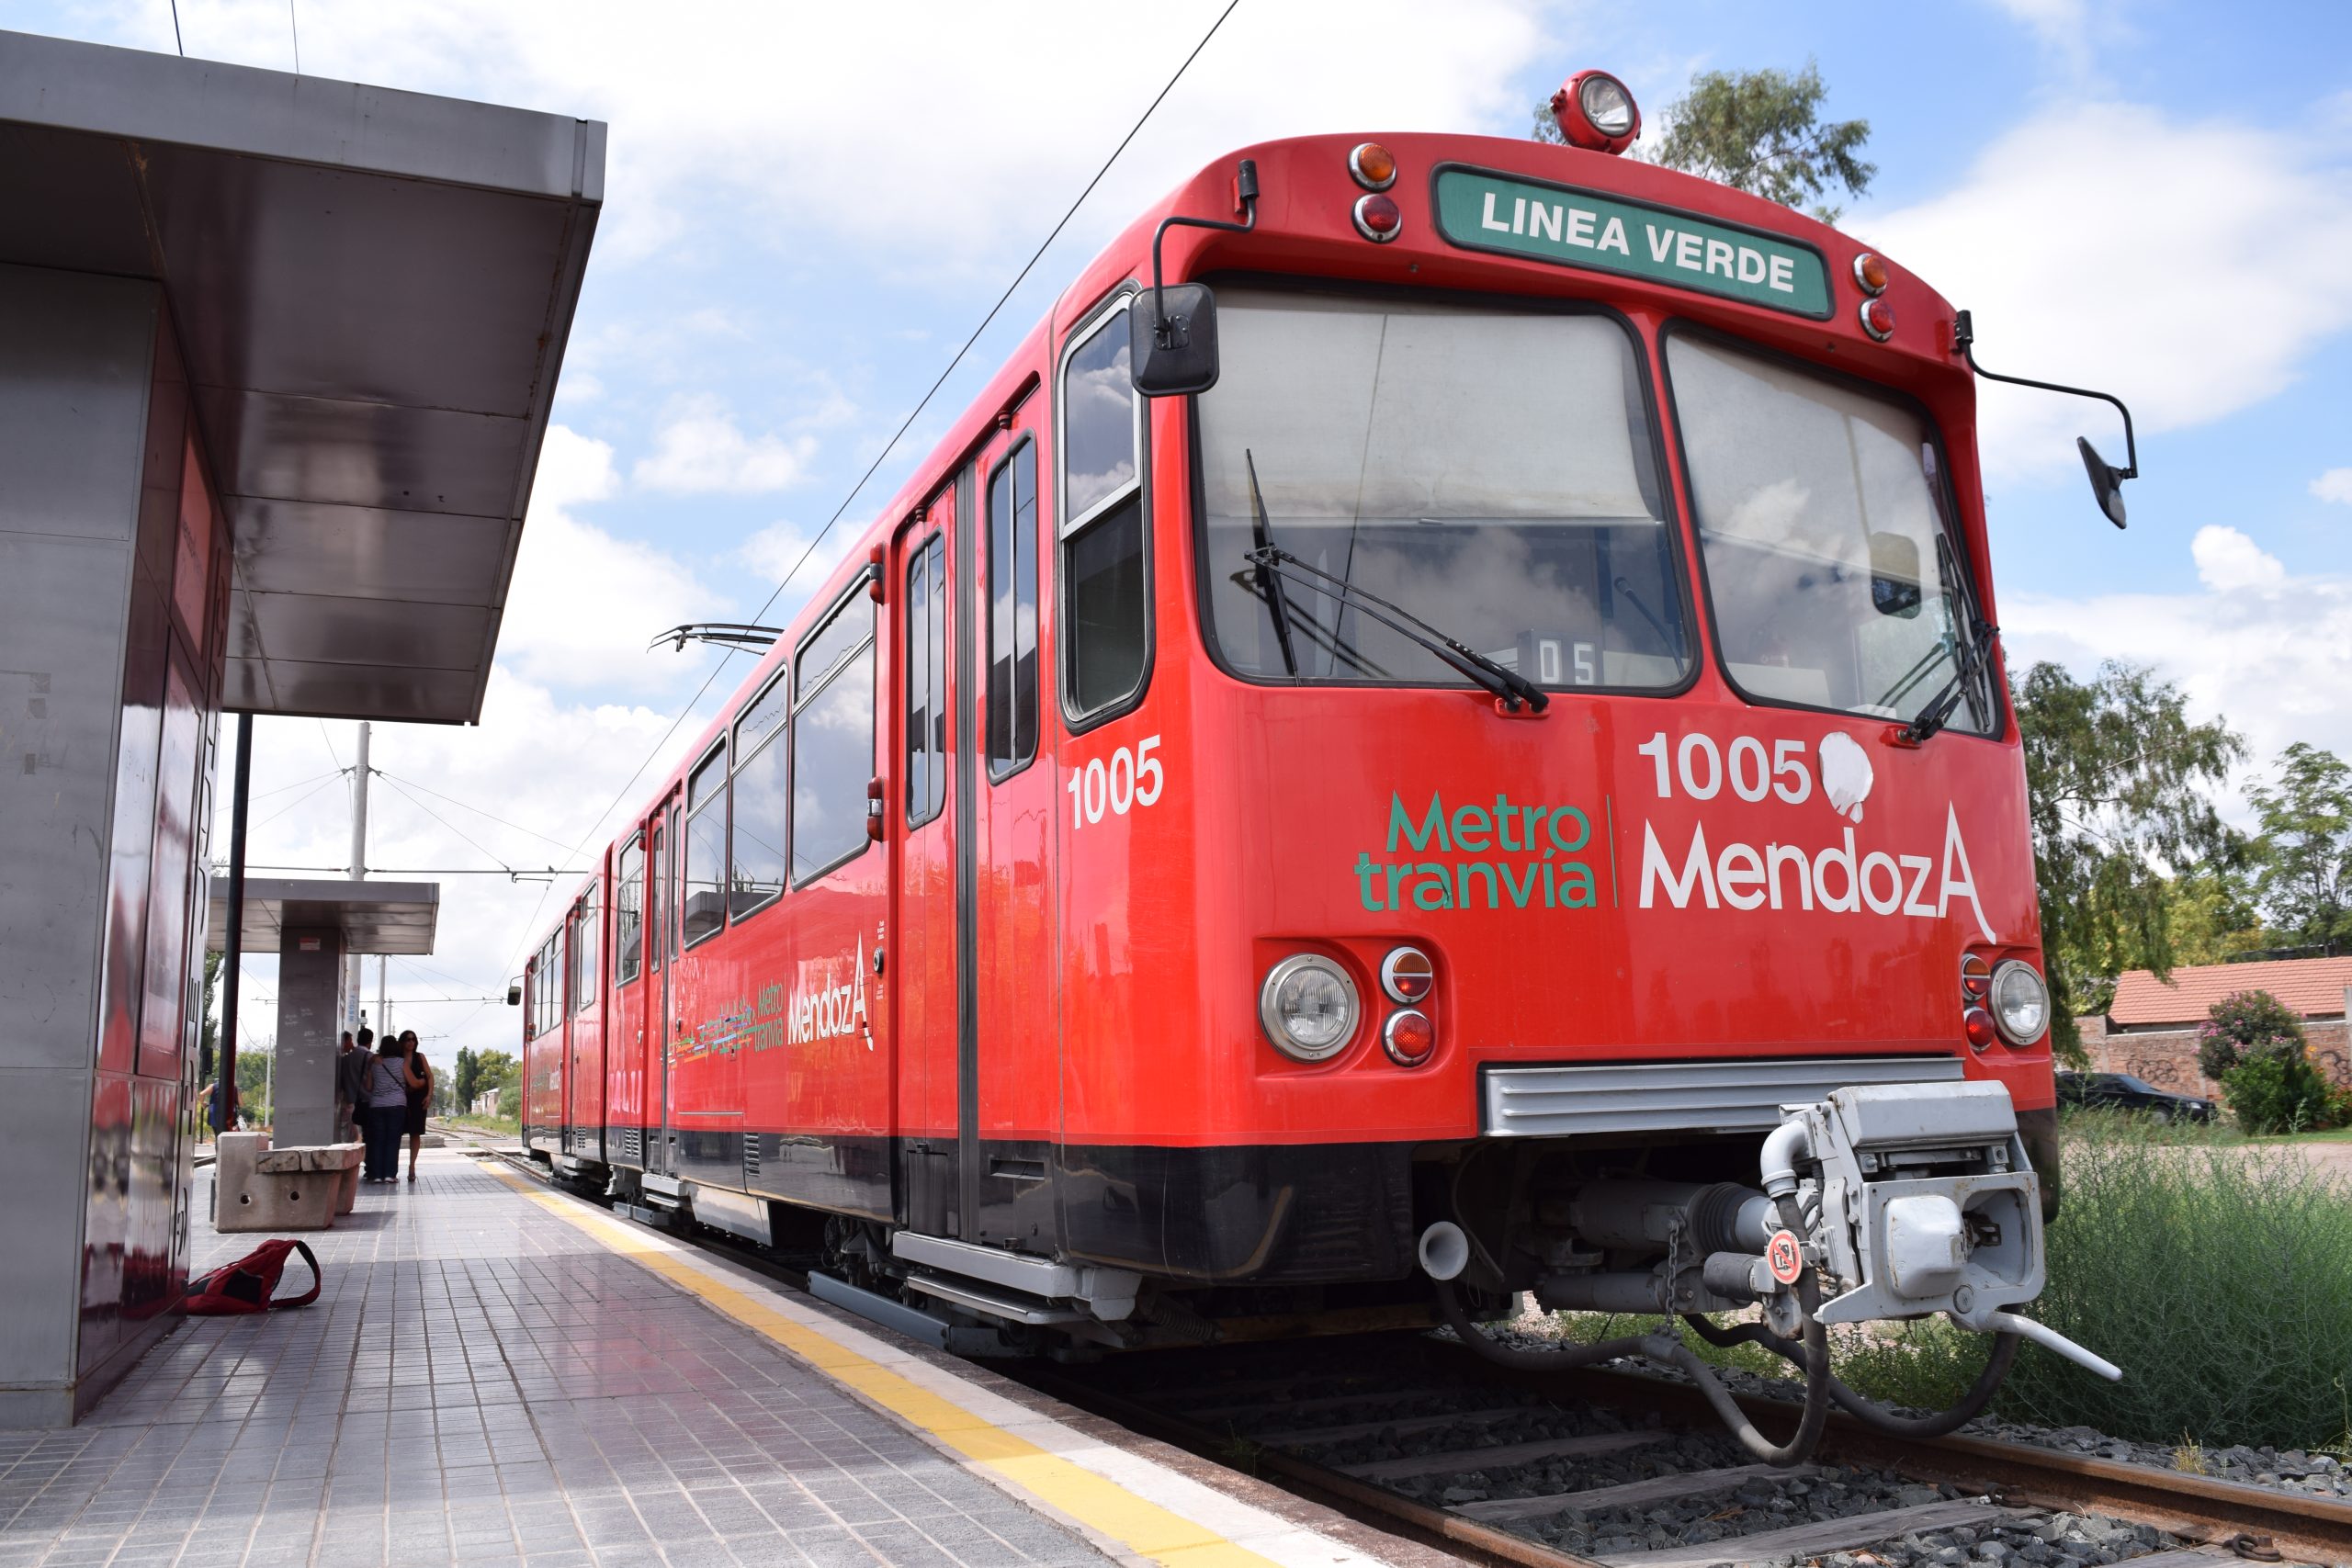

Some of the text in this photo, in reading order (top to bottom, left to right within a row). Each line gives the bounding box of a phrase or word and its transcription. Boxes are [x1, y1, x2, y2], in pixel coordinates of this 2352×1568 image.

[1481, 193, 1794, 293] LINEA VERDE
[1067, 734, 1164, 830] 1005
[1638, 731, 1812, 805] 1005
[1386, 789, 1591, 853] Metro
[1354, 848, 1597, 911] tranvía
[1640, 800, 1996, 945] MendozA
[758, 979, 783, 1019] Metro
